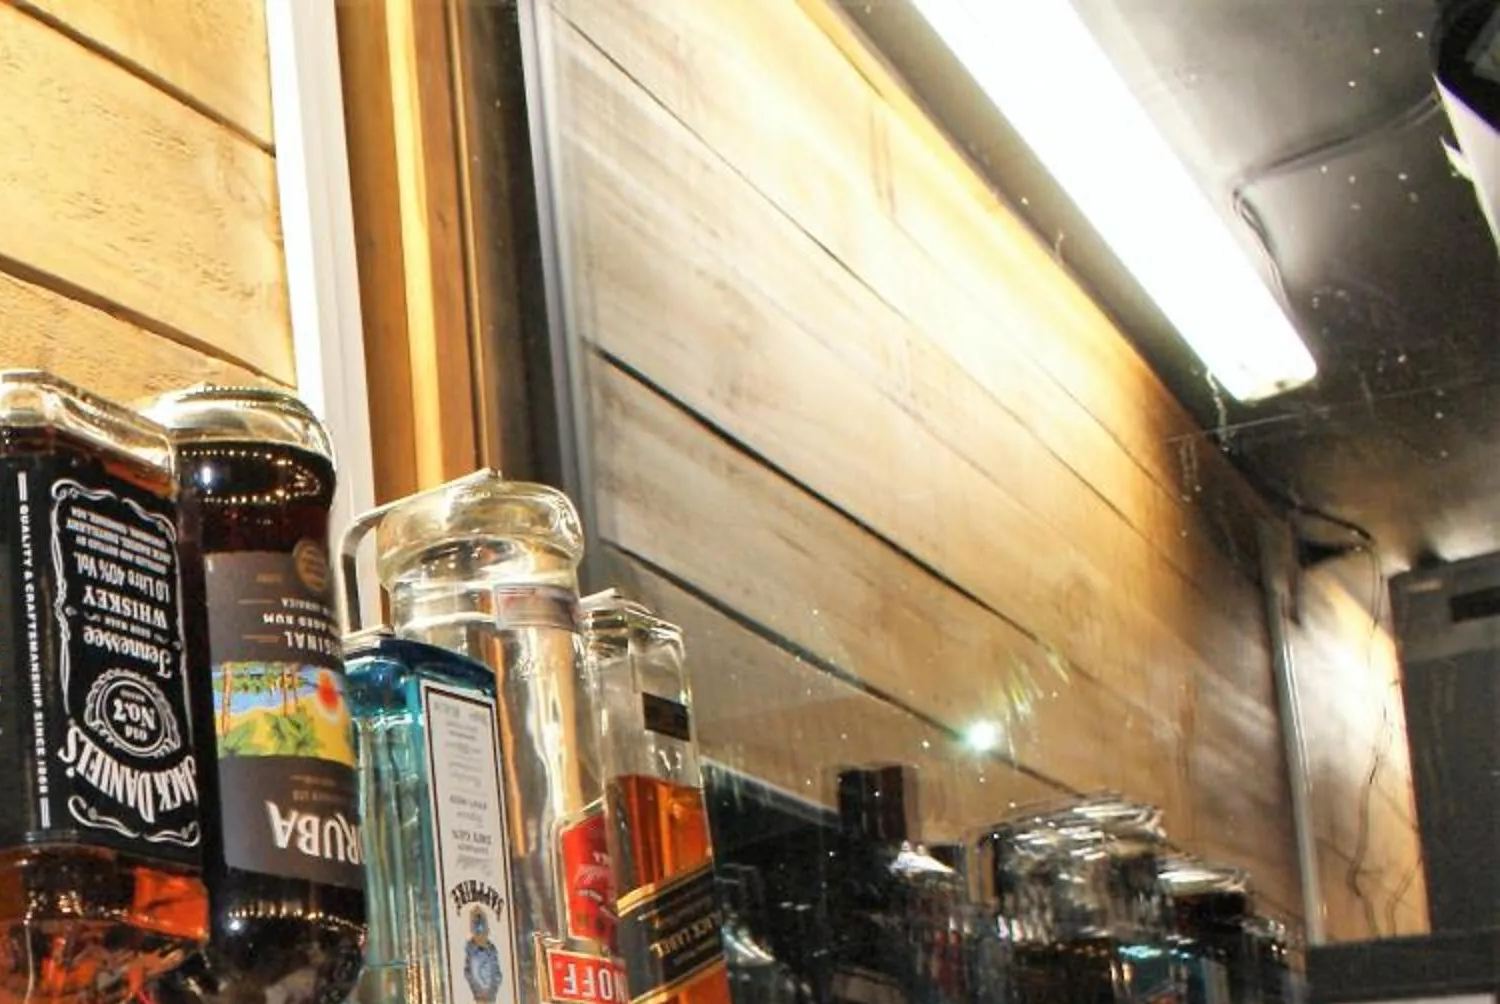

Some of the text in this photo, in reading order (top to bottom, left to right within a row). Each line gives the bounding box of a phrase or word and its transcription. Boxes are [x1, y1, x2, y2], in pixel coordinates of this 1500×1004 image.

[20, 503, 33, 567] QUALITY
[127, 568, 155, 598] Litre
[83, 585, 168, 630] WHISKEY
[263, 612, 294, 625] RUM
[25, 583, 43, 708] CRAFTSMANSHIP
[83, 625, 173, 679] Tennessee
[33, 712, 46, 756] SINCE
[57, 726, 199, 823] JACK DANIEL'S
[451, 880, 506, 922] SAPPHIRE
[562, 963, 628, 1004] NOFF
